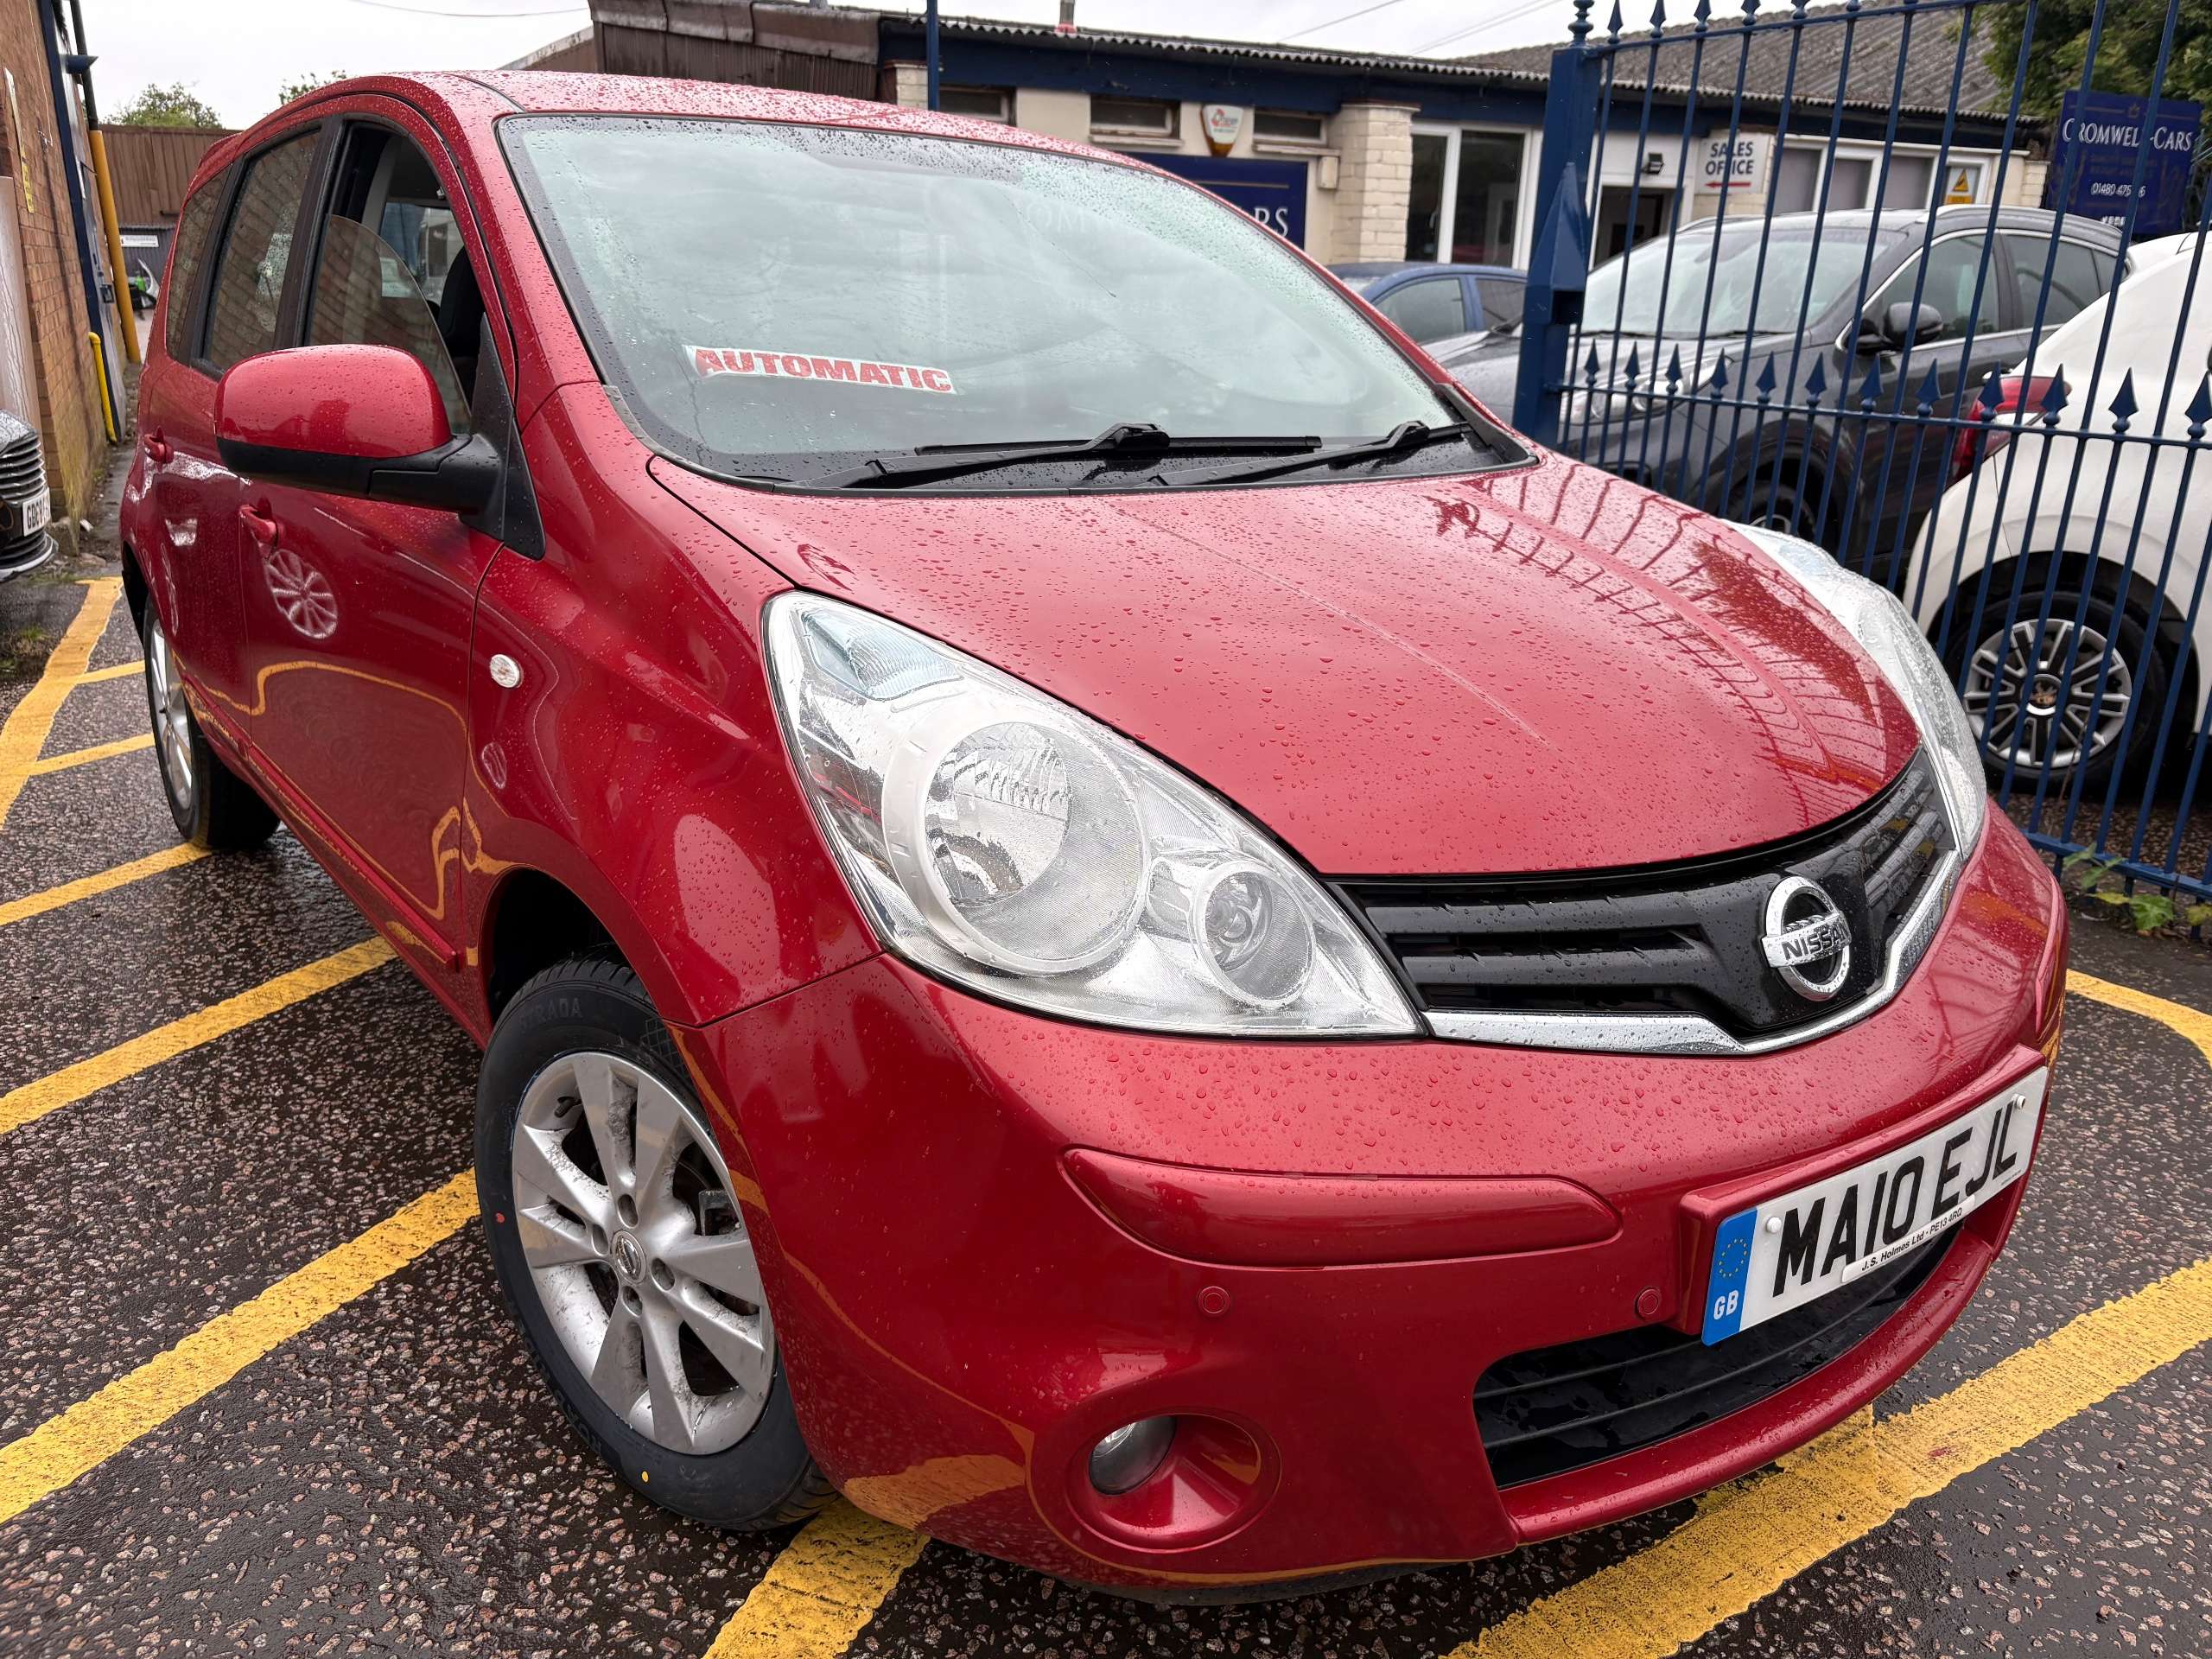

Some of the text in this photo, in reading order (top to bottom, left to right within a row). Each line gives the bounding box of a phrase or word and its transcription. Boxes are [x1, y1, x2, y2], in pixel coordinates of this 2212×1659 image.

[2063, 118, 2148, 148] CROMWEL
[1705, 160, 1754, 175] OFICE
[695, 348, 951, 391] AUTOMATIC
[1781, 921, 1848, 960] NISSAN
[1773, 1102, 2018, 1298] MA10 EJL
[1880, 1238, 1910, 1262] Holmes
[1911, 1230, 1925, 1246] Ltd
[1929, 1217, 1948, 1235] PE13
[1713, 1289, 1738, 1319] GB
